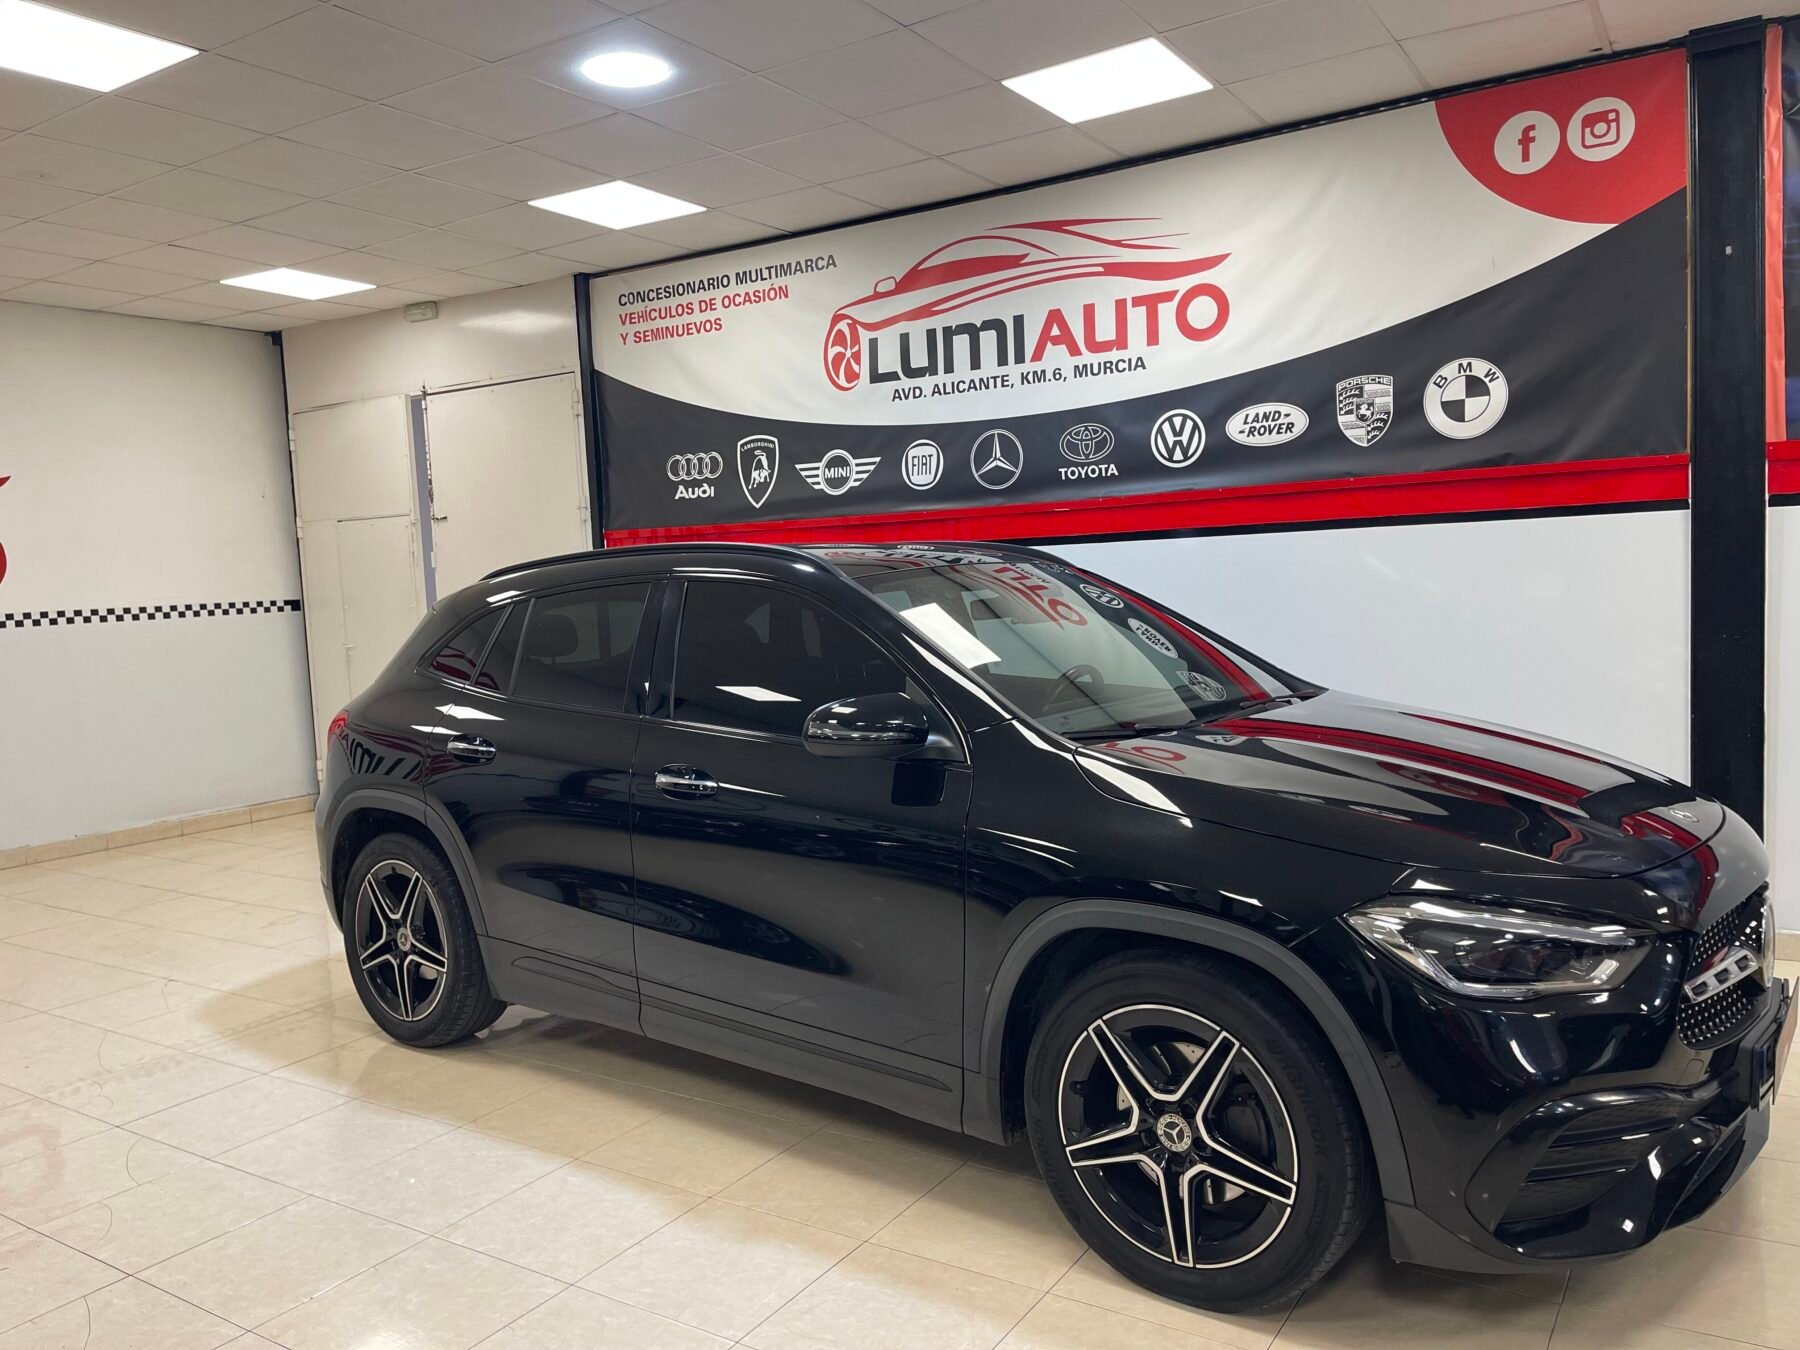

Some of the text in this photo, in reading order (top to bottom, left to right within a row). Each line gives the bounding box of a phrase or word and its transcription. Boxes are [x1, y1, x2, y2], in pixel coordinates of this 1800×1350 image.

[617, 253, 838, 307] CONCESIONARIO MULTIMARCA
[618, 283, 790, 327] VEHÍCULOS DE OCASIÓN
[619, 317, 723, 346] Y SEMINUEVOS
[890, 355, 1148, 402] AVD. ALICANTE, KM.6, MURCIA
[1338, 375, 1392, 391] PORSCHE
[740, 441, 775, 452] LAMBORGHINI
[824, 465, 850, 480] MINI
[911, 454, 934, 477] FIAT
[1058, 463, 1120, 481] TOYOTA
[674, 482, 715, 500] Audi
